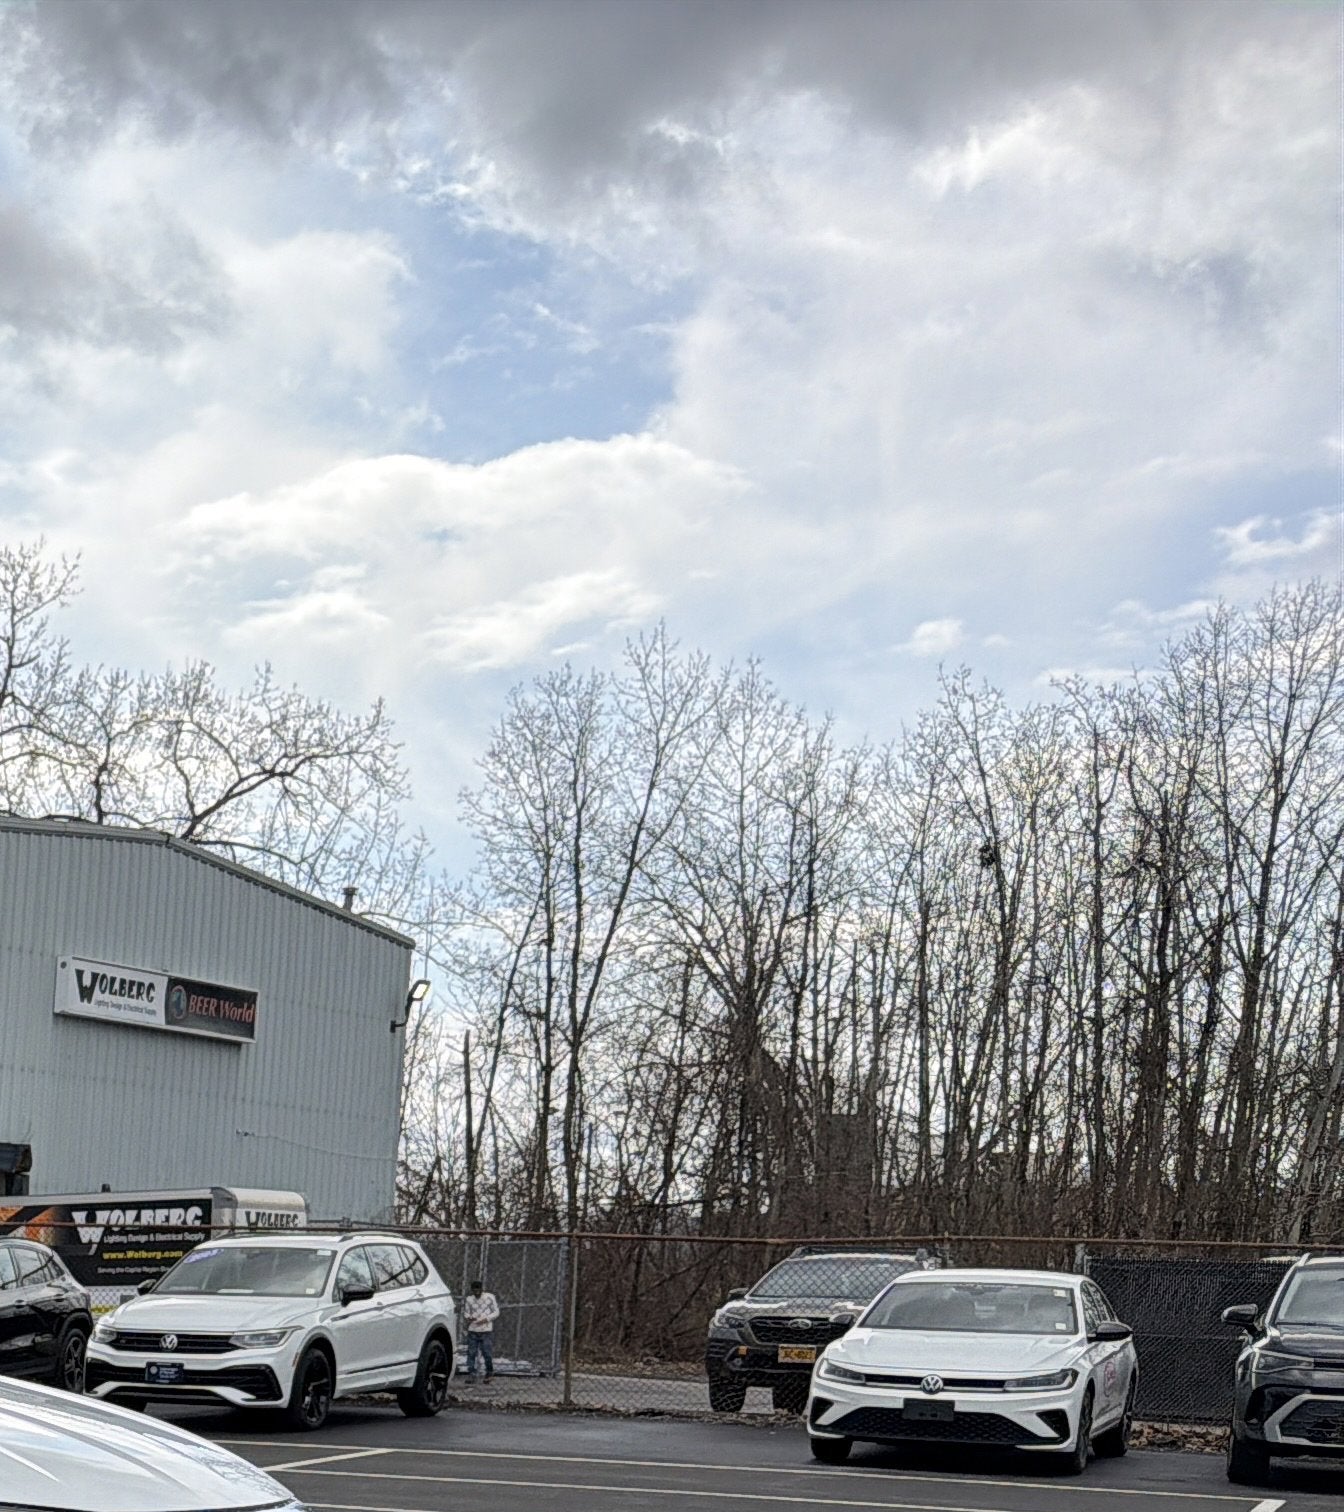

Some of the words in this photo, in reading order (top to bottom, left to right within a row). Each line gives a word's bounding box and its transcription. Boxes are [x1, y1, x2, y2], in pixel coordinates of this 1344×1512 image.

[75, 968, 155, 1004] WOLBERG
[189, 995, 216, 1017] BEER
[219, 1000, 254, 1023] World
[71, 1206, 203, 1243] WOLBERG
[245, 1211, 299, 1231] WOLBERG
[102, 1250, 183, 1260] www.Wolberg.com
